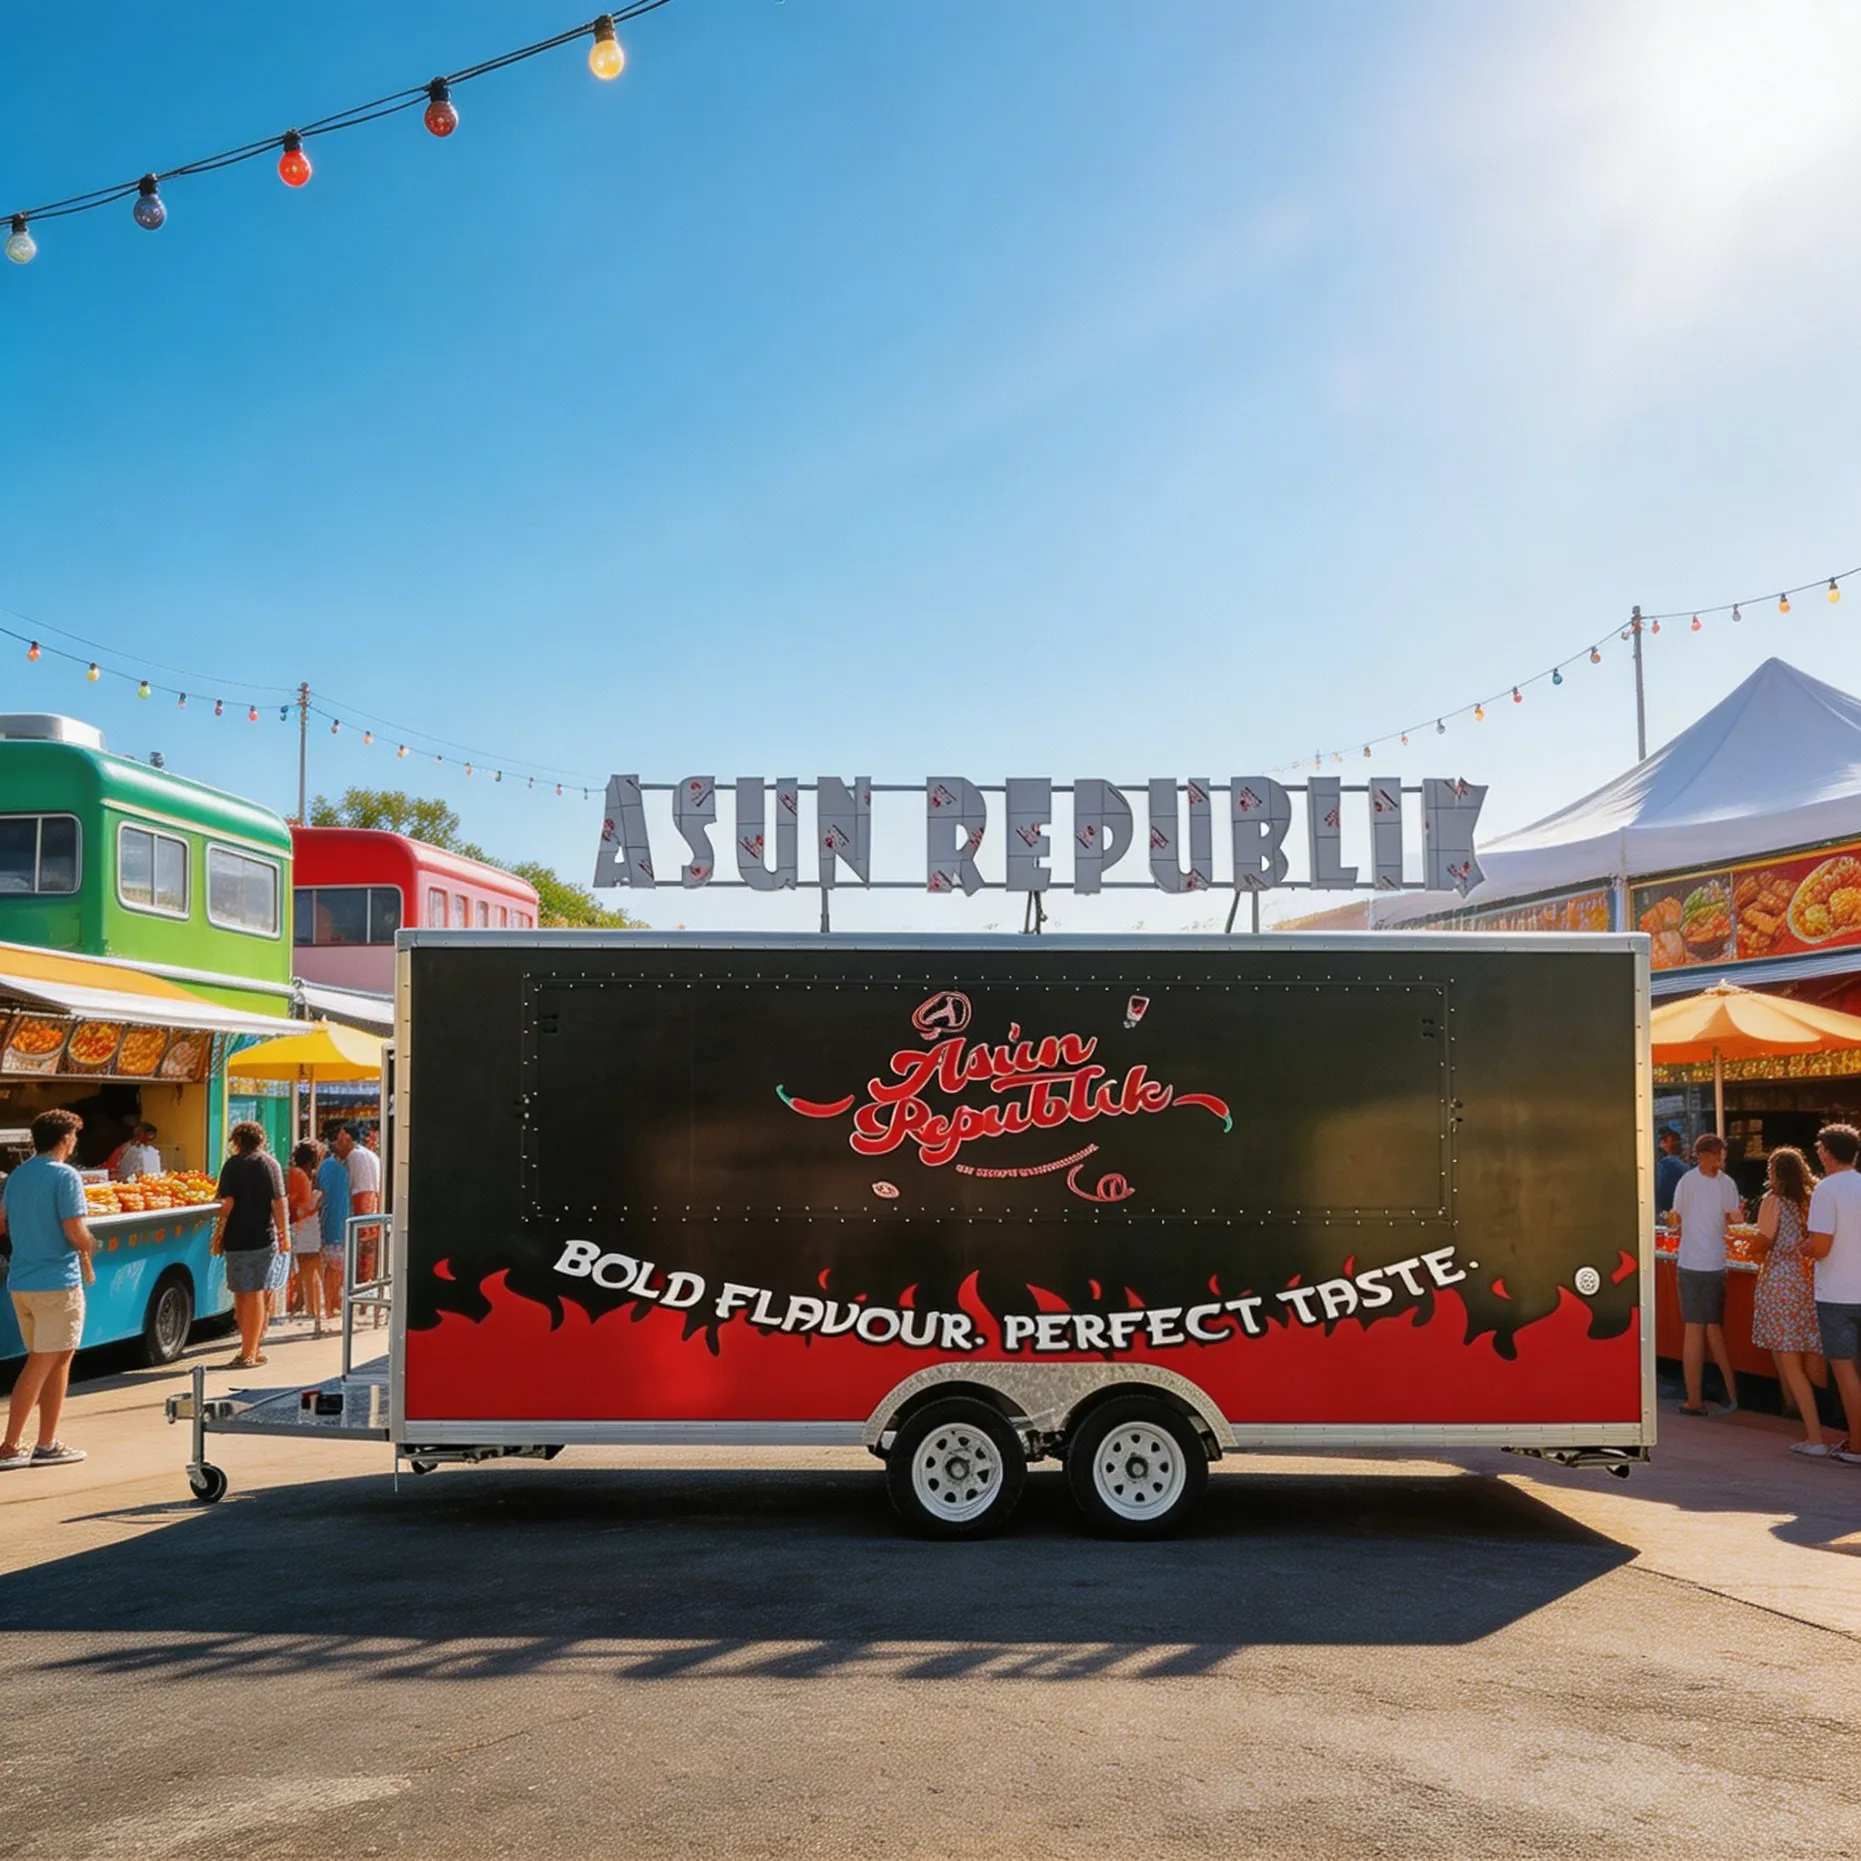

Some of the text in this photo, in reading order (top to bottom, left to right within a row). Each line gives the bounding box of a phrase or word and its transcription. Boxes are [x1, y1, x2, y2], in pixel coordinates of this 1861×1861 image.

[592, 774, 1488, 899] ASUN REPUBLIK
[553, 1239, 1480, 1351] BOLD FLAVOUR. PERFECT TASTE.
